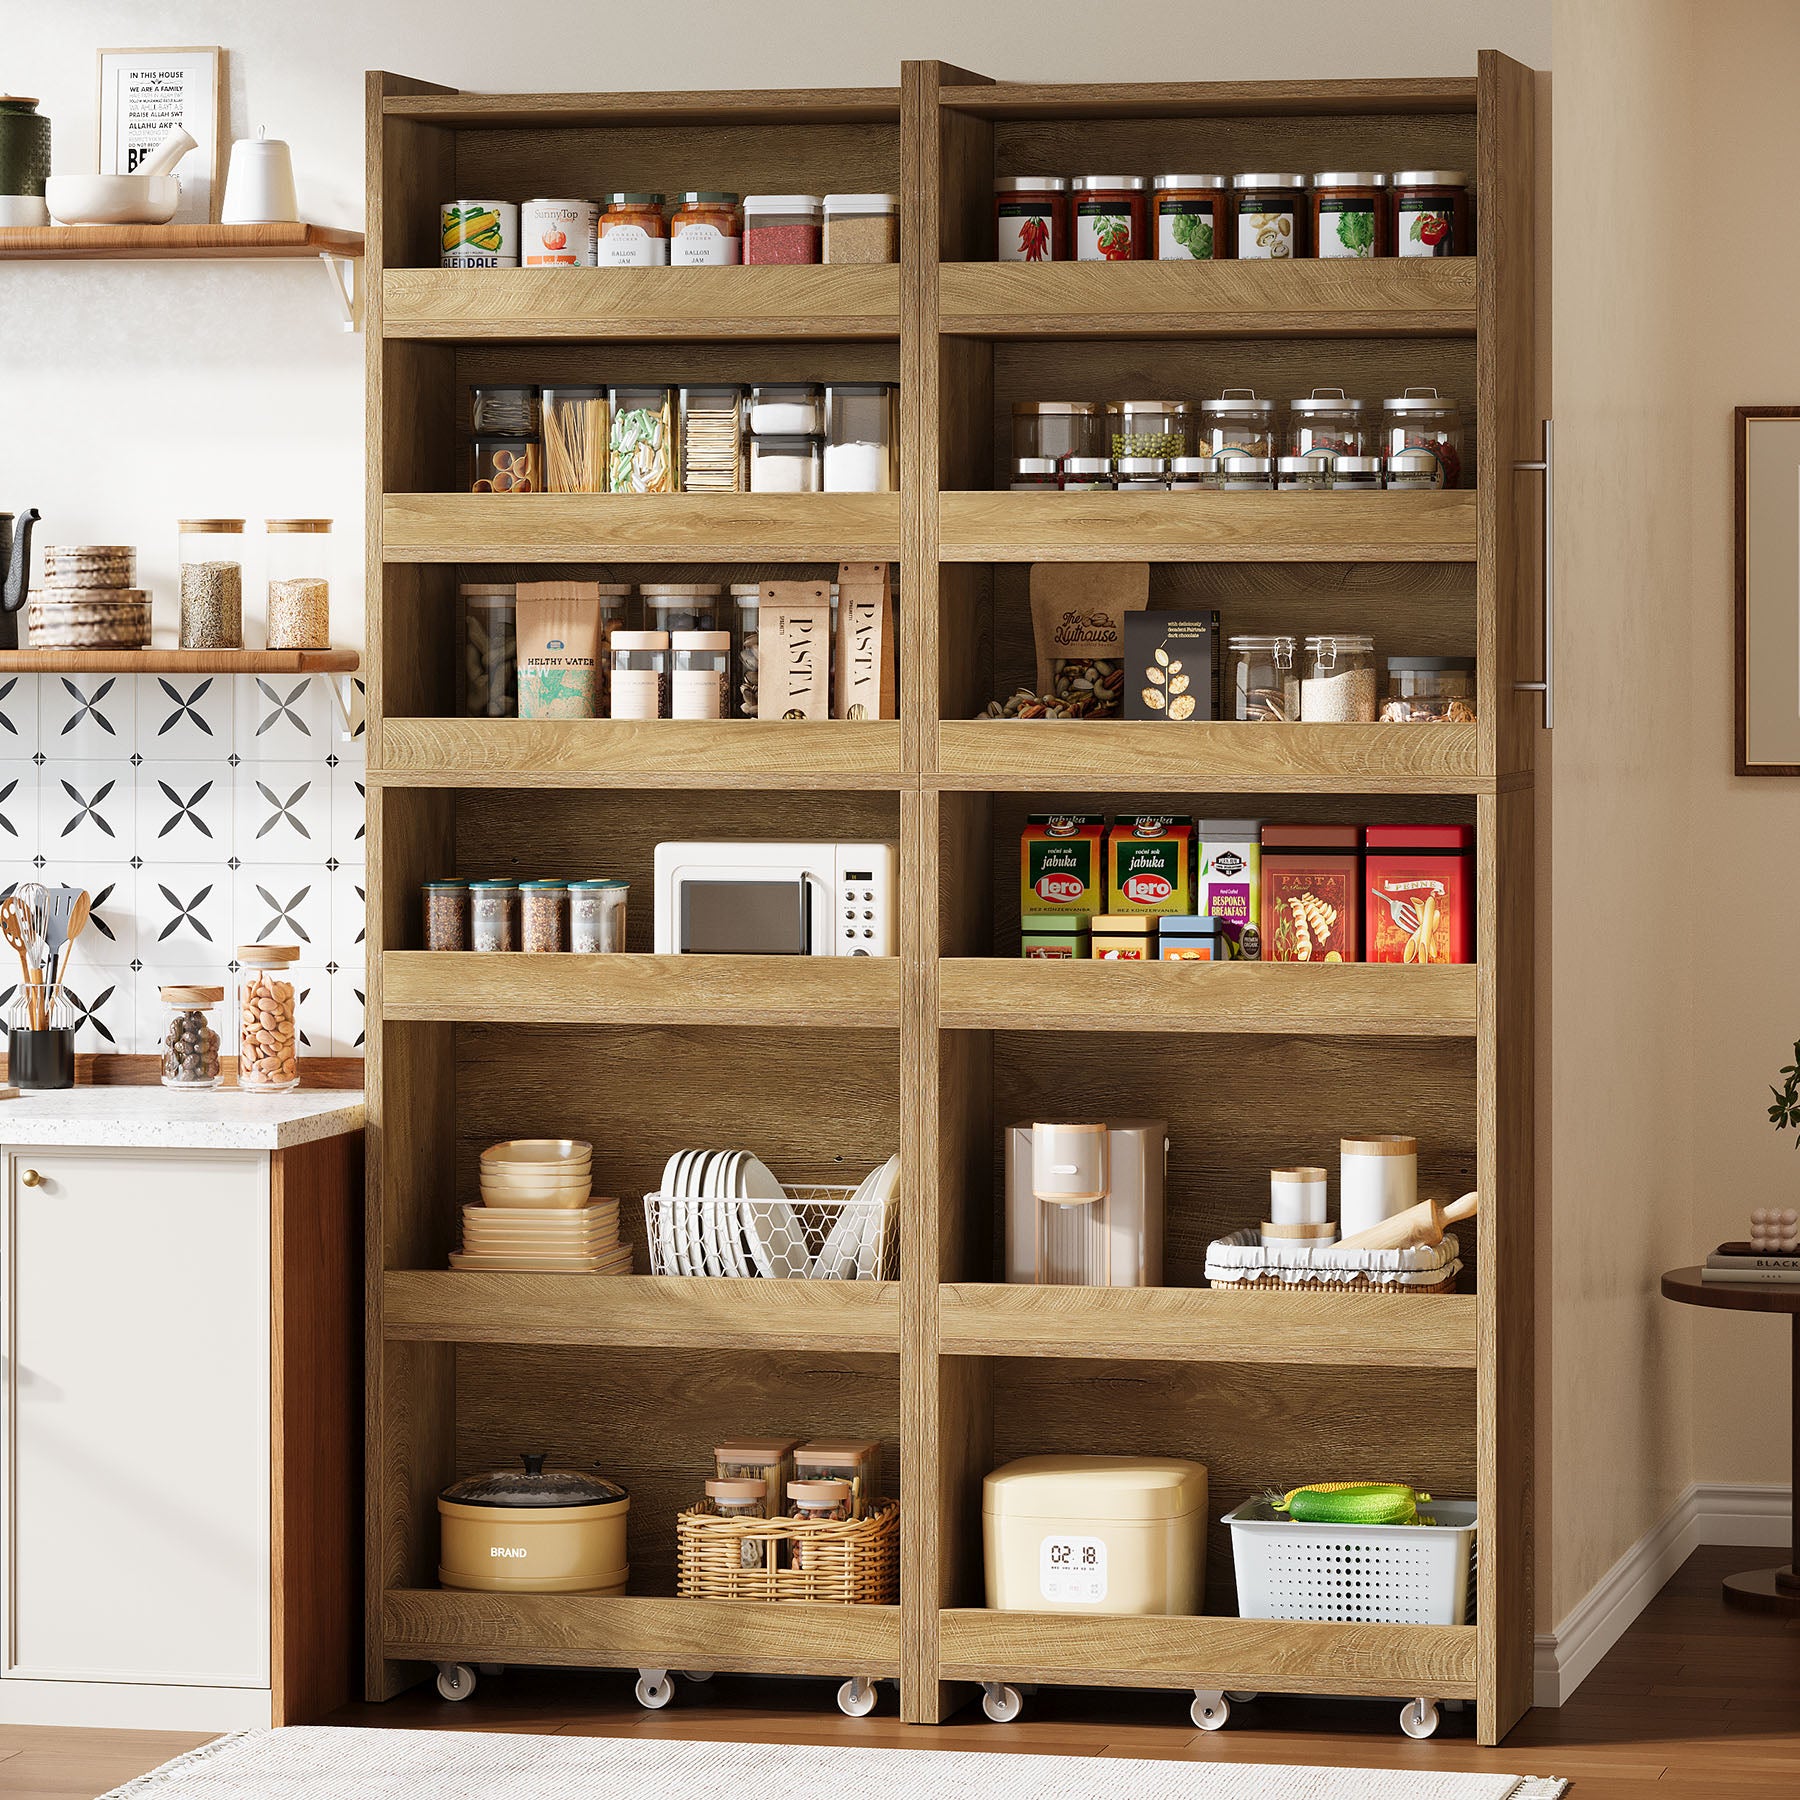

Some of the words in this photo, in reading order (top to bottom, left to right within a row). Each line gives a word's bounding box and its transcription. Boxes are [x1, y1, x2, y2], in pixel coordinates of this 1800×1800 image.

[129, 122, 157, 130] ALLAHU
[1062, 609, 1083, 627] The
[1054, 625, 1118, 646] Nuthouse
[855, 603, 874, 686] PASTA
[527, 658, 563, 666] HELTHY
[565, 658, 595, 666] WATER
[789, 619, 813, 697] PASTA
[1040, 855, 1077, 870] jabuka
[1128, 855, 1165, 871] jabuka
[1281, 876, 1337, 886] PASTA
[1395, 881, 1438, 891] PENNE
[1040, 878, 1082, 899] Lero
[1128, 879, 1169, 900] Lero
[1212, 895, 1246, 906] BESPOKEN
[1211, 906, 1247, 917] BREAKFAST
[1756, 1260, 1799, 1268] BLACK
[490, 1547, 527, 1558] BRAND
